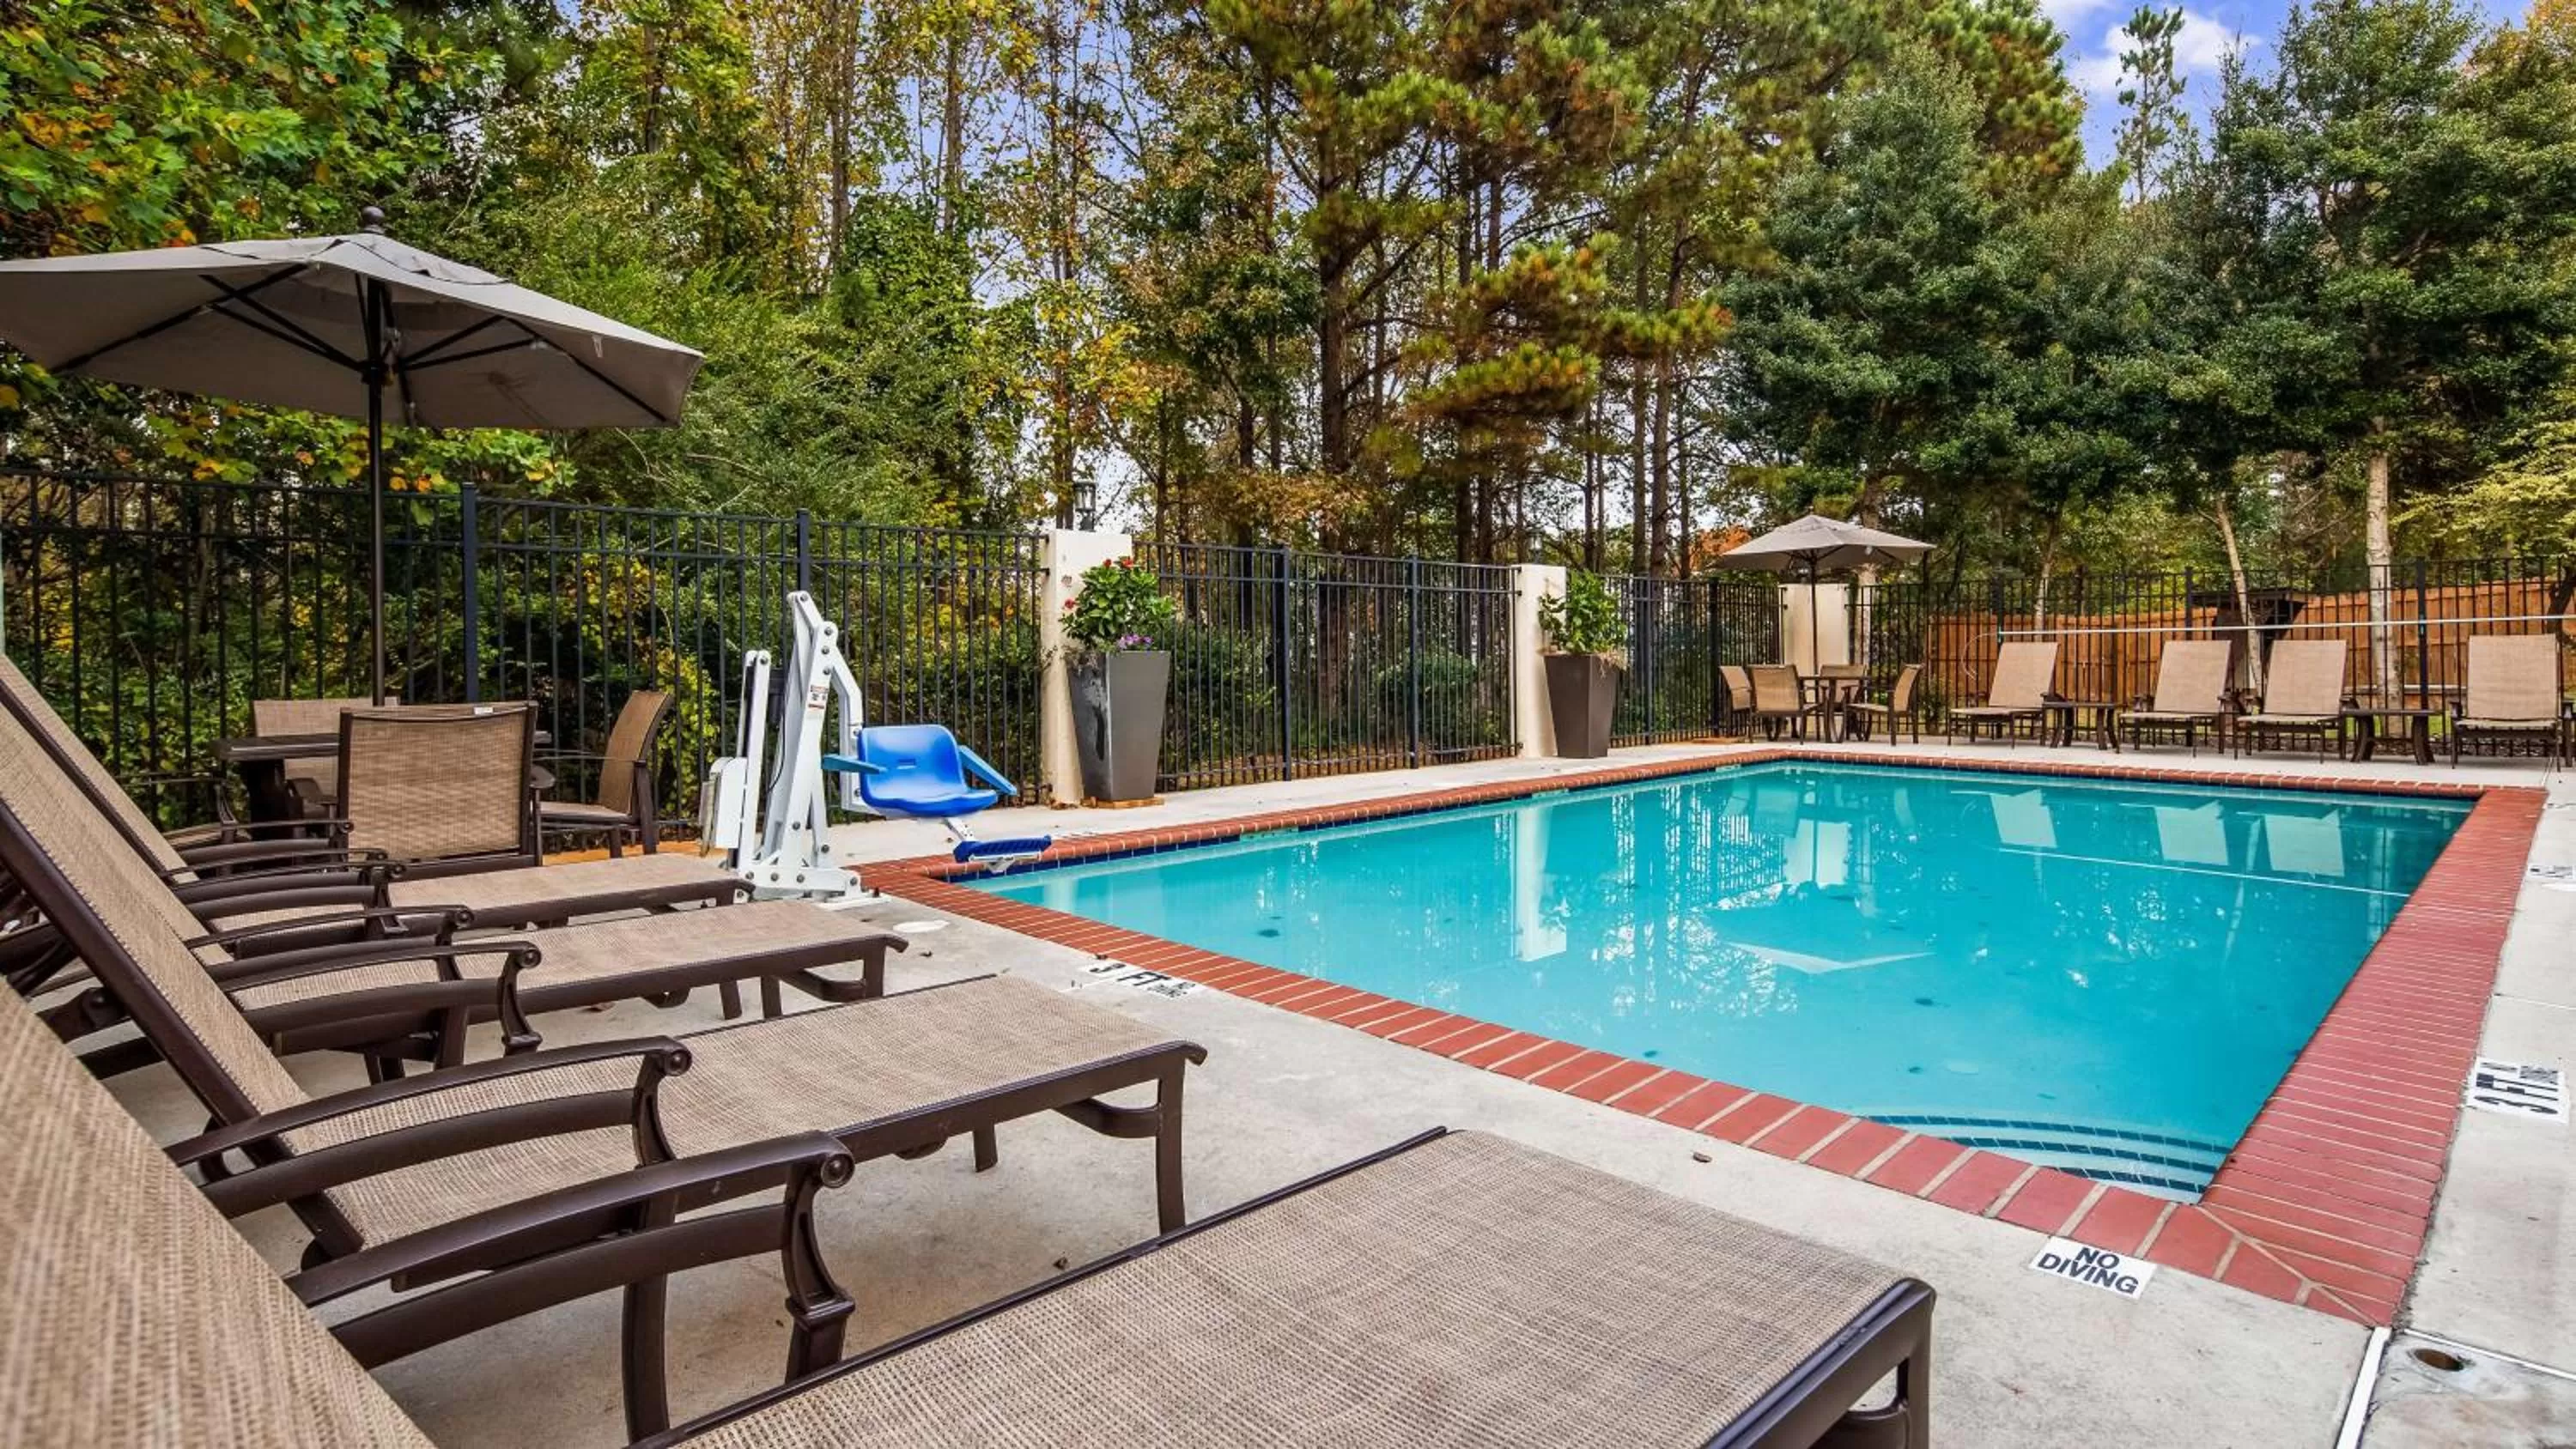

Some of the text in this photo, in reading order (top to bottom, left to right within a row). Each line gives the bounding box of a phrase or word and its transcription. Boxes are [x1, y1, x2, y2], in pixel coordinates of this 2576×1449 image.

[1116, 971, 1171, 986] FT
[2476, 1073, 2559, 1101] FT
[2473, 1095, 2559, 1114] 3
[2075, 1246, 2121, 1270] NO
[2038, 1252, 2140, 1294] DIVING
